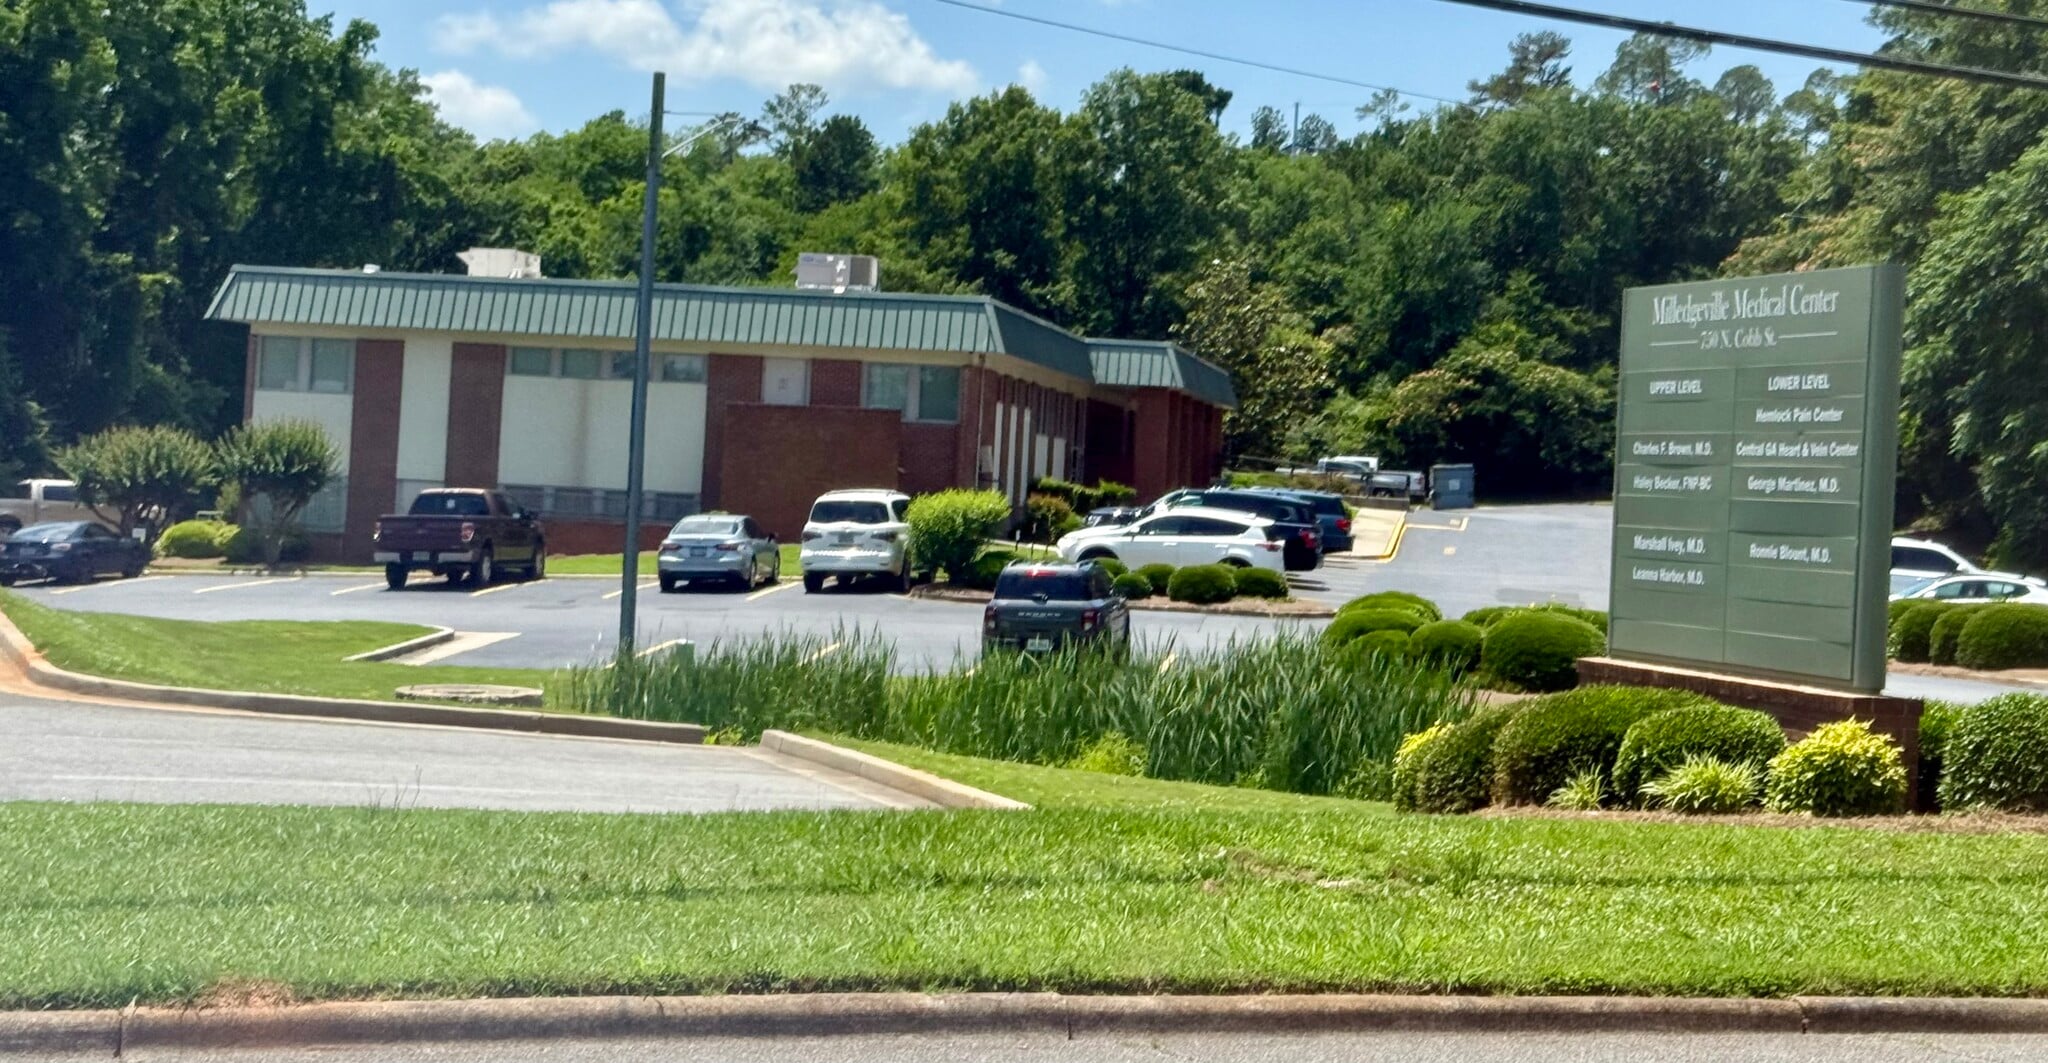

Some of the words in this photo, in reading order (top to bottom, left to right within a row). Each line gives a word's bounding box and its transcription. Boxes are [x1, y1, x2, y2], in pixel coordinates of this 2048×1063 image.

[1652, 291, 1729, 328] Milledgeville
[1732, 285, 1787, 319] Medical
[1790, 284, 1840, 315] Center
[1734, 327, 1762, 348] Cobb
[1650, 381, 1676, 394] UPPER
[1677, 380, 1703, 394] LEVEL
[1768, 375, 1800, 391] LOWER
[1801, 374, 1830, 390] LEVEL
[1756, 408, 1792, 422] Hemlock
[1793, 407, 1812, 422] Pain
[1813, 406, 1844, 422] Center
[1633, 441, 1660, 455] Charles
[1660, 441, 1668, 455] F.
[1695, 441, 1713, 456] M.D.
[1736, 441, 1765, 456] Central
[1765, 442, 1777, 456] GA
[1778, 442, 1801, 457] Heart
[1802, 442, 1809, 457] &
[1810, 442, 1829, 457] Vein
[1829, 442, 1859, 457] Center
[1633, 475, 1654, 491] Haley
[1748, 475, 1777, 493] George
[1818, 477, 1841, 493] M.D.
[1634, 535, 1668, 551] Marshall
[1686, 537, 1706, 554] M.D.
[1750, 543, 1778, 559] Ronnie
[1810, 546, 1832, 564] M.D.
[1687, 569, 1705, 586] M.D.
